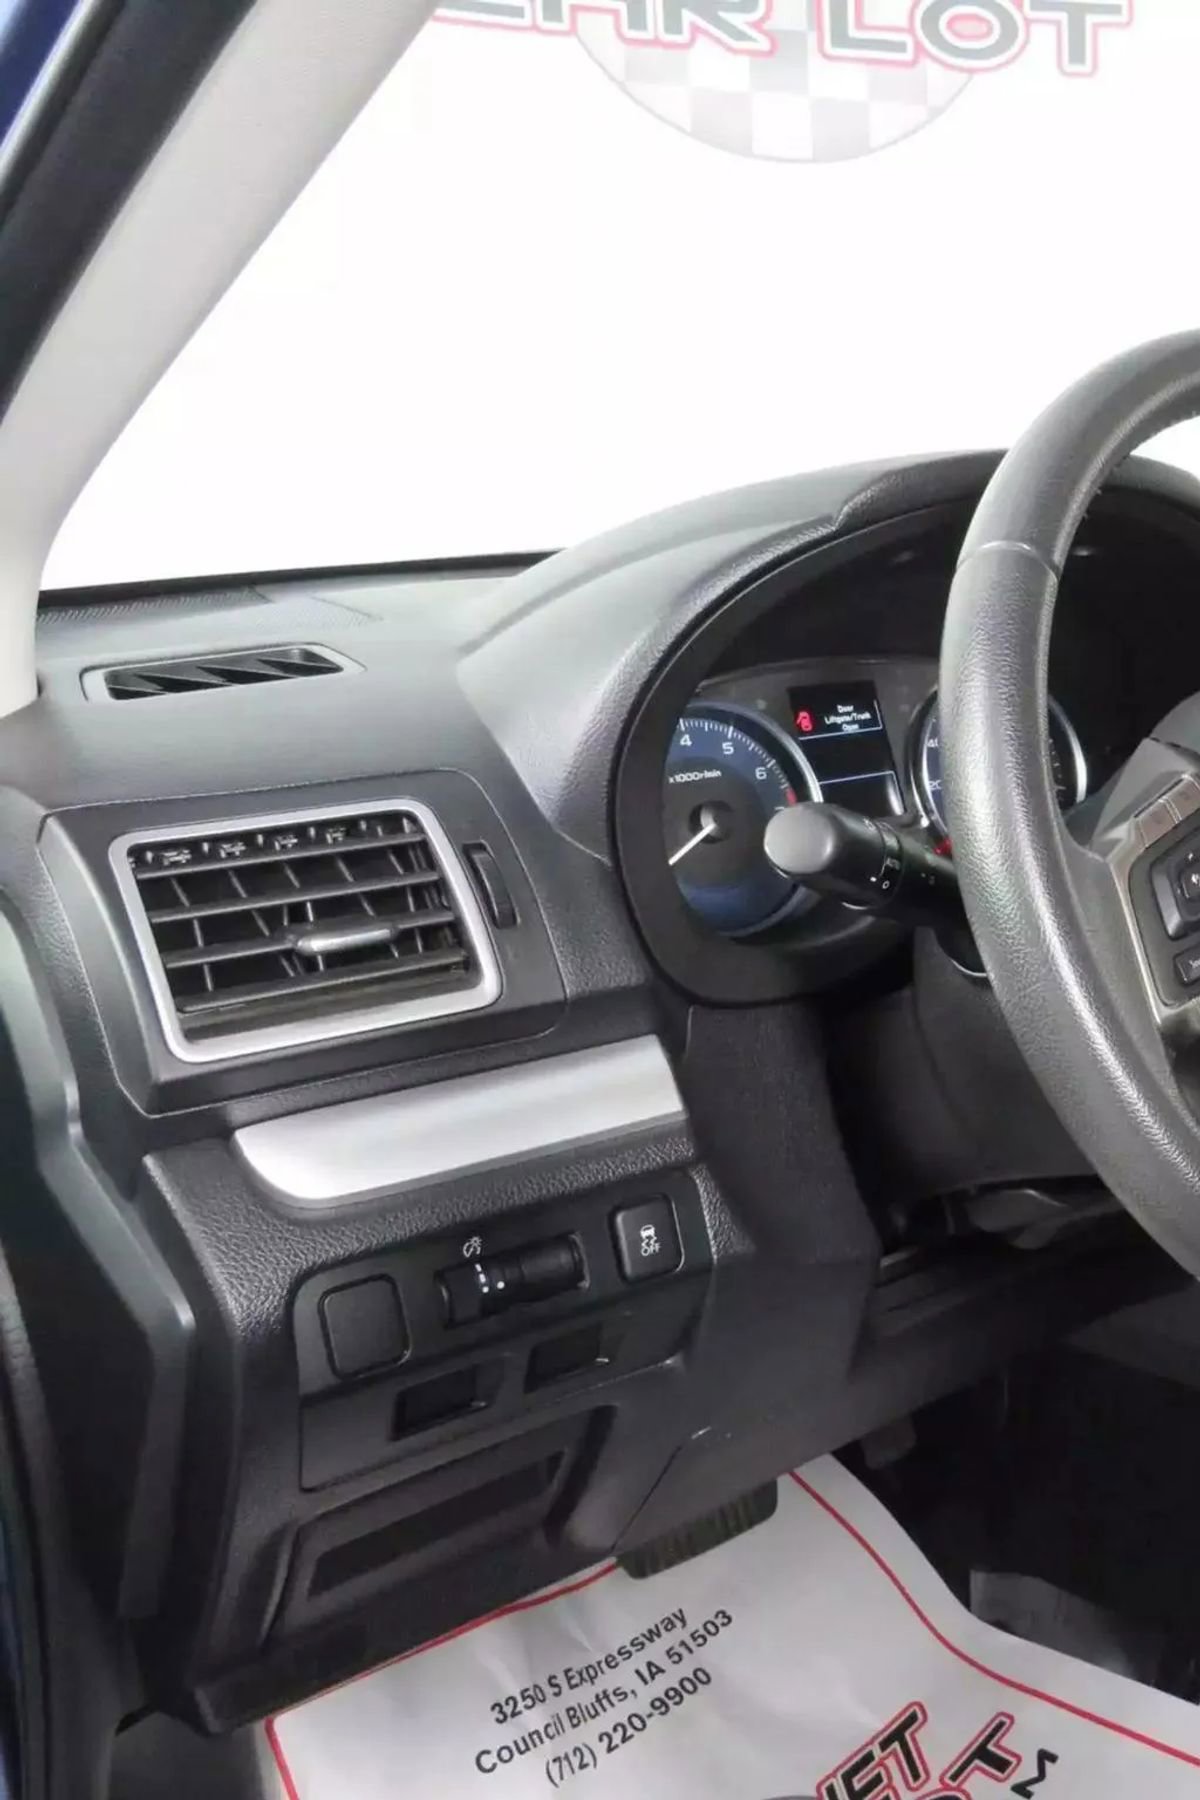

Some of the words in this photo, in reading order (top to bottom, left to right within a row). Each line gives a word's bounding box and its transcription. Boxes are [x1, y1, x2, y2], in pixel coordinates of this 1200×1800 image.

[680, 734, 692, 746] 4
[722, 742, 734, 755] 5
[755, 767, 767, 779] 6
[475, 1713, 566, 1774] Council
[566, 1684, 638, 1730] Bluffs,
[635, 1660, 667, 1686] IA
[665, 1609, 733, 1666] 51503
[490, 1684, 546, 1725] 3250
[549, 1675, 563, 1697] S
[563, 1608, 688, 1691] Expressway
[545, 1742, 598, 1789] (712)
[598, 1667, 712, 1754] 220-9900
